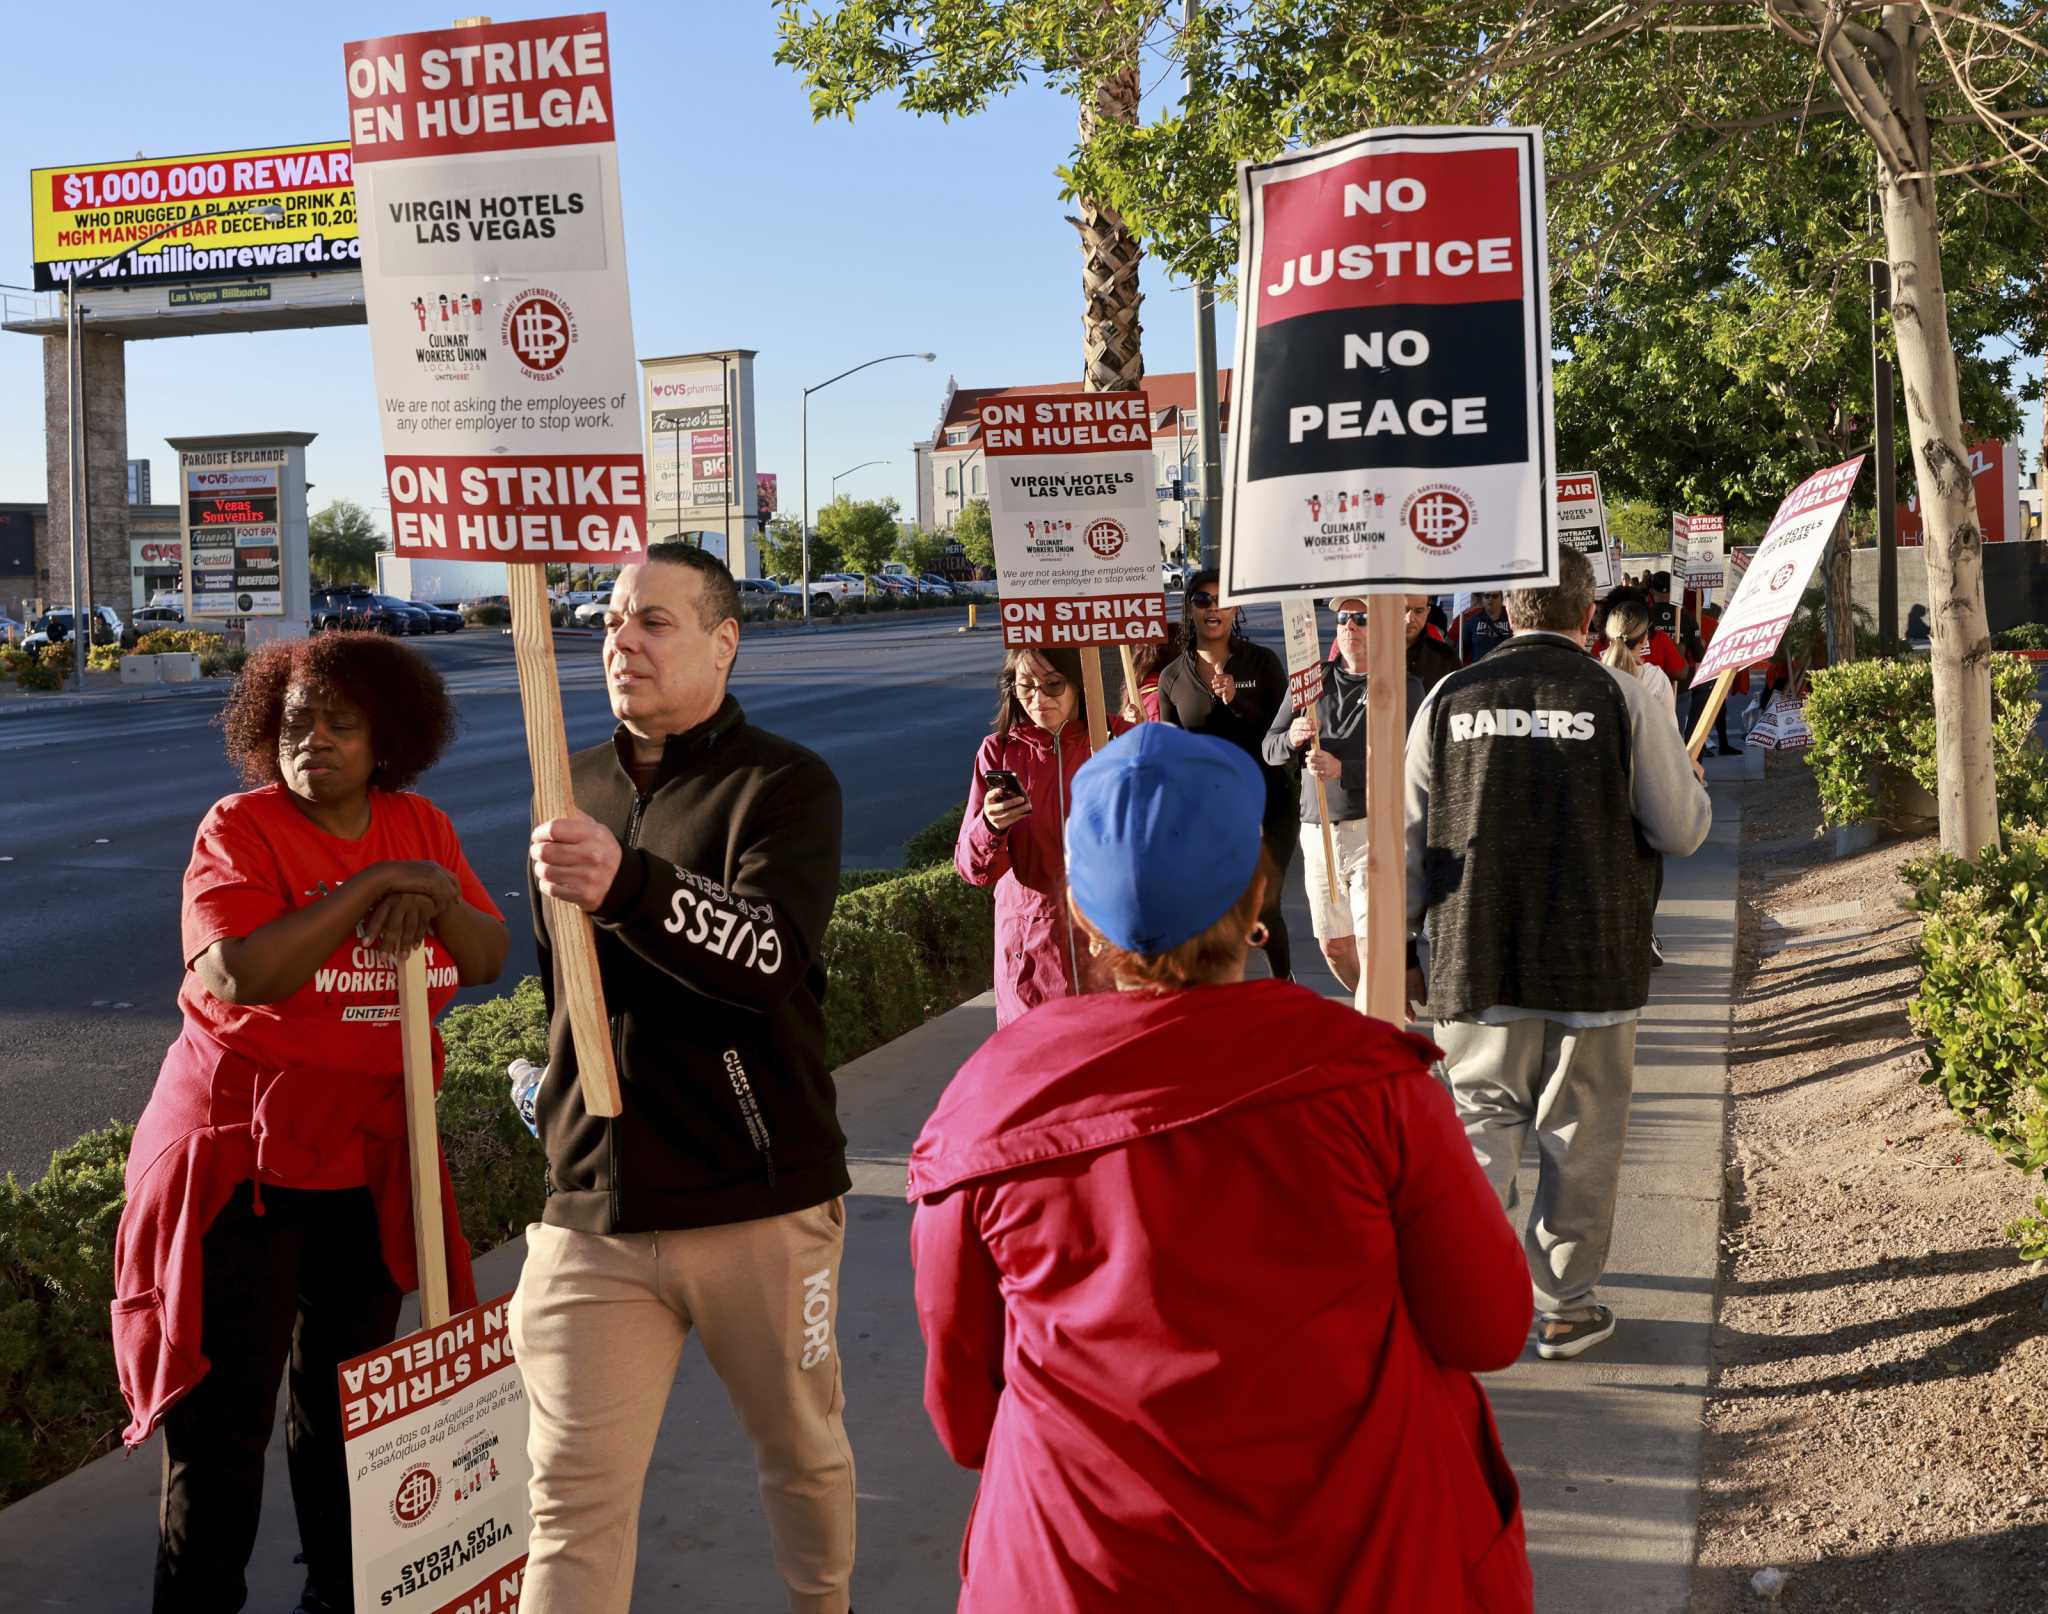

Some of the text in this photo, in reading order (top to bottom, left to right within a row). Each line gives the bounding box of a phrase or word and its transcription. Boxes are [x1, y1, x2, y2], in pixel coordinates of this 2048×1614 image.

[348, 32, 604, 99] ON STRIKE
[352, 85, 608, 145] EN HUELGA
[63, 152, 353, 208] $1,000,000 REWAR
[389, 193, 585, 223] VIRGIN HOTELS
[1343, 178, 1427, 217] NO
[75, 212, 110, 228] WHO
[114, 205, 186, 225] DRUGGED
[191, 204, 201, 218] A
[286, 193, 335, 211] DRINK
[58, 229, 95, 247] MGM
[100, 223, 178, 243] MANSION
[182, 219, 217, 238] BAR
[221, 214, 307, 234] DECEMBER
[416, 218, 556, 244] LAS VEGAS
[1266, 237, 1513, 297] JUSTICE
[170, 286, 269, 303] Las Vegas Billboards
[515, 287, 558, 302] BARTENDERS
[429, 334, 469, 348] CULINARY
[1344, 329, 1430, 369] NO
[416, 348, 487, 363] WORKERS UNION
[520, 367, 533, 379] LAS
[664, 383, 724, 397] CVS pharmac
[385, 392, 626, 416] We are not asking the employees of
[981, 399, 1147, 425] ON STRIKE
[397, 412, 614, 433] any other employer to stop work.
[1289, 396, 1488, 444] PEACE
[985, 423, 1148, 448] EN HUELGA
[182, 449, 285, 466] PARADISE ESPLANADE
[207, 473, 268, 485] CVS pharmacy
[390, 465, 641, 506] ON STRIKE
[1011, 472, 1134, 488] VIRGIN HOTELS
[1797, 463, 1859, 500] STRIKE
[1029, 484, 1117, 498] LAS VEGAS
[1790, 482, 1849, 514] HUELGA
[215, 498, 251, 511] Vegas
[1562, 508, 1593, 516] HOTELS
[202, 510, 264, 523] Souvenirs
[1321, 521, 1368, 535] CULINARY
[1690, 523, 1723, 531] HUELGA
[1692, 516, 1722, 525] STRIKE
[236, 527, 277, 537] FOOT SPA
[396, 512, 642, 552] EN HUELGA
[1303, 531, 1385, 548] WORKERS UNION
[1784, 519, 1825, 538] HOTELS
[142, 543, 182, 562] CVS
[237, 575, 279, 586] UNDEFEATED
[1002, 564, 1156, 579] We are not asking the employees of
[1010, 573, 1148, 587] any other employer to stop work.
[1691, 573, 1723, 581] STRIKE
[1003, 598, 1164, 622] ON STRIKE
[1006, 621, 1165, 644] EN HUELGA
[1724, 619, 1786, 649] STRIKE
[1711, 642, 1778, 671] HUELGA
[1290, 675, 1302, 692] ON
[1292, 693, 1303, 706] EN
[1450, 708, 1595, 742] RAIDERS
[664, 888, 782, 975] GUESS
[314, 966, 458, 993] WORKER NION
[345, 1007, 400, 1019] UNITEHE
[722, 1049, 750, 1096] GUESS
[800, 1268, 831, 1370] KORS
[342, 1318, 475, 1394] HUELGA
[346, 1336, 515, 1432] ON STRIKE
[493, 1399, 507, 1412] are
[506, 1388, 524, 1405] We
[365, 1379, 517, 1461] any other employer to stop work.
[475, 1403, 489, 1420] not
[448, 1410, 472, 1437] asking
[430, 1428, 445, 1445] the
[370, 1438, 426, 1472] employees
[357, 1464, 368, 1482] of
[401, 1516, 495, 1580] LAS VEGAS
[460, 1522, 513, 1567] VIRGIN
[380, 1557, 455, 1607] HOTELS
